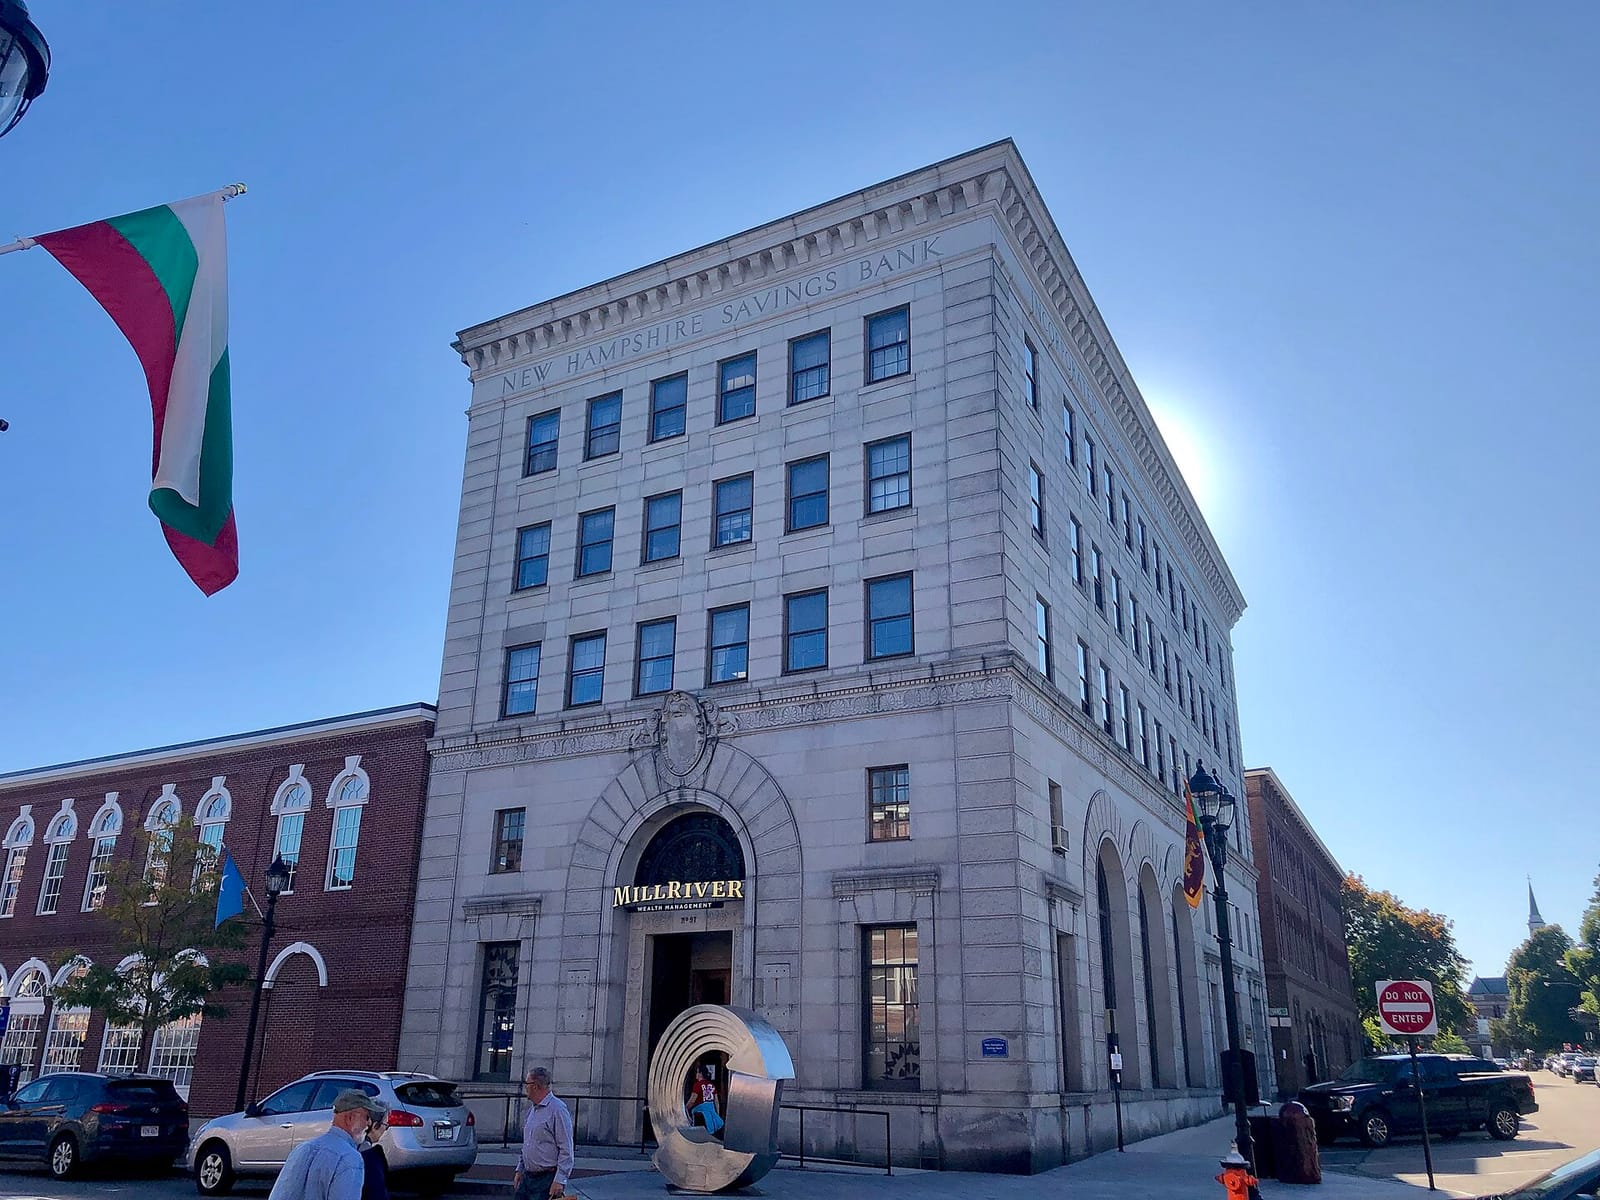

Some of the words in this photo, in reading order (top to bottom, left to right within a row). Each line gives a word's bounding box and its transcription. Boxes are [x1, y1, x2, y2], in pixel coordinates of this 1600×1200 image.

[502, 362, 552, 393] NEW
[567, 315, 704, 374] HAMPSHIRE
[721, 271, 837, 324] SAVINGS
[859, 236, 944, 281] BANK
[637, 904, 662, 912] WEALTH
[664, 902, 712, 911] MANAGEMENT
[1385, 991, 1399, 1000] DO
[1404, 991, 1424, 1000] NOT
[1392, 1014, 1424, 1023] ENTER
